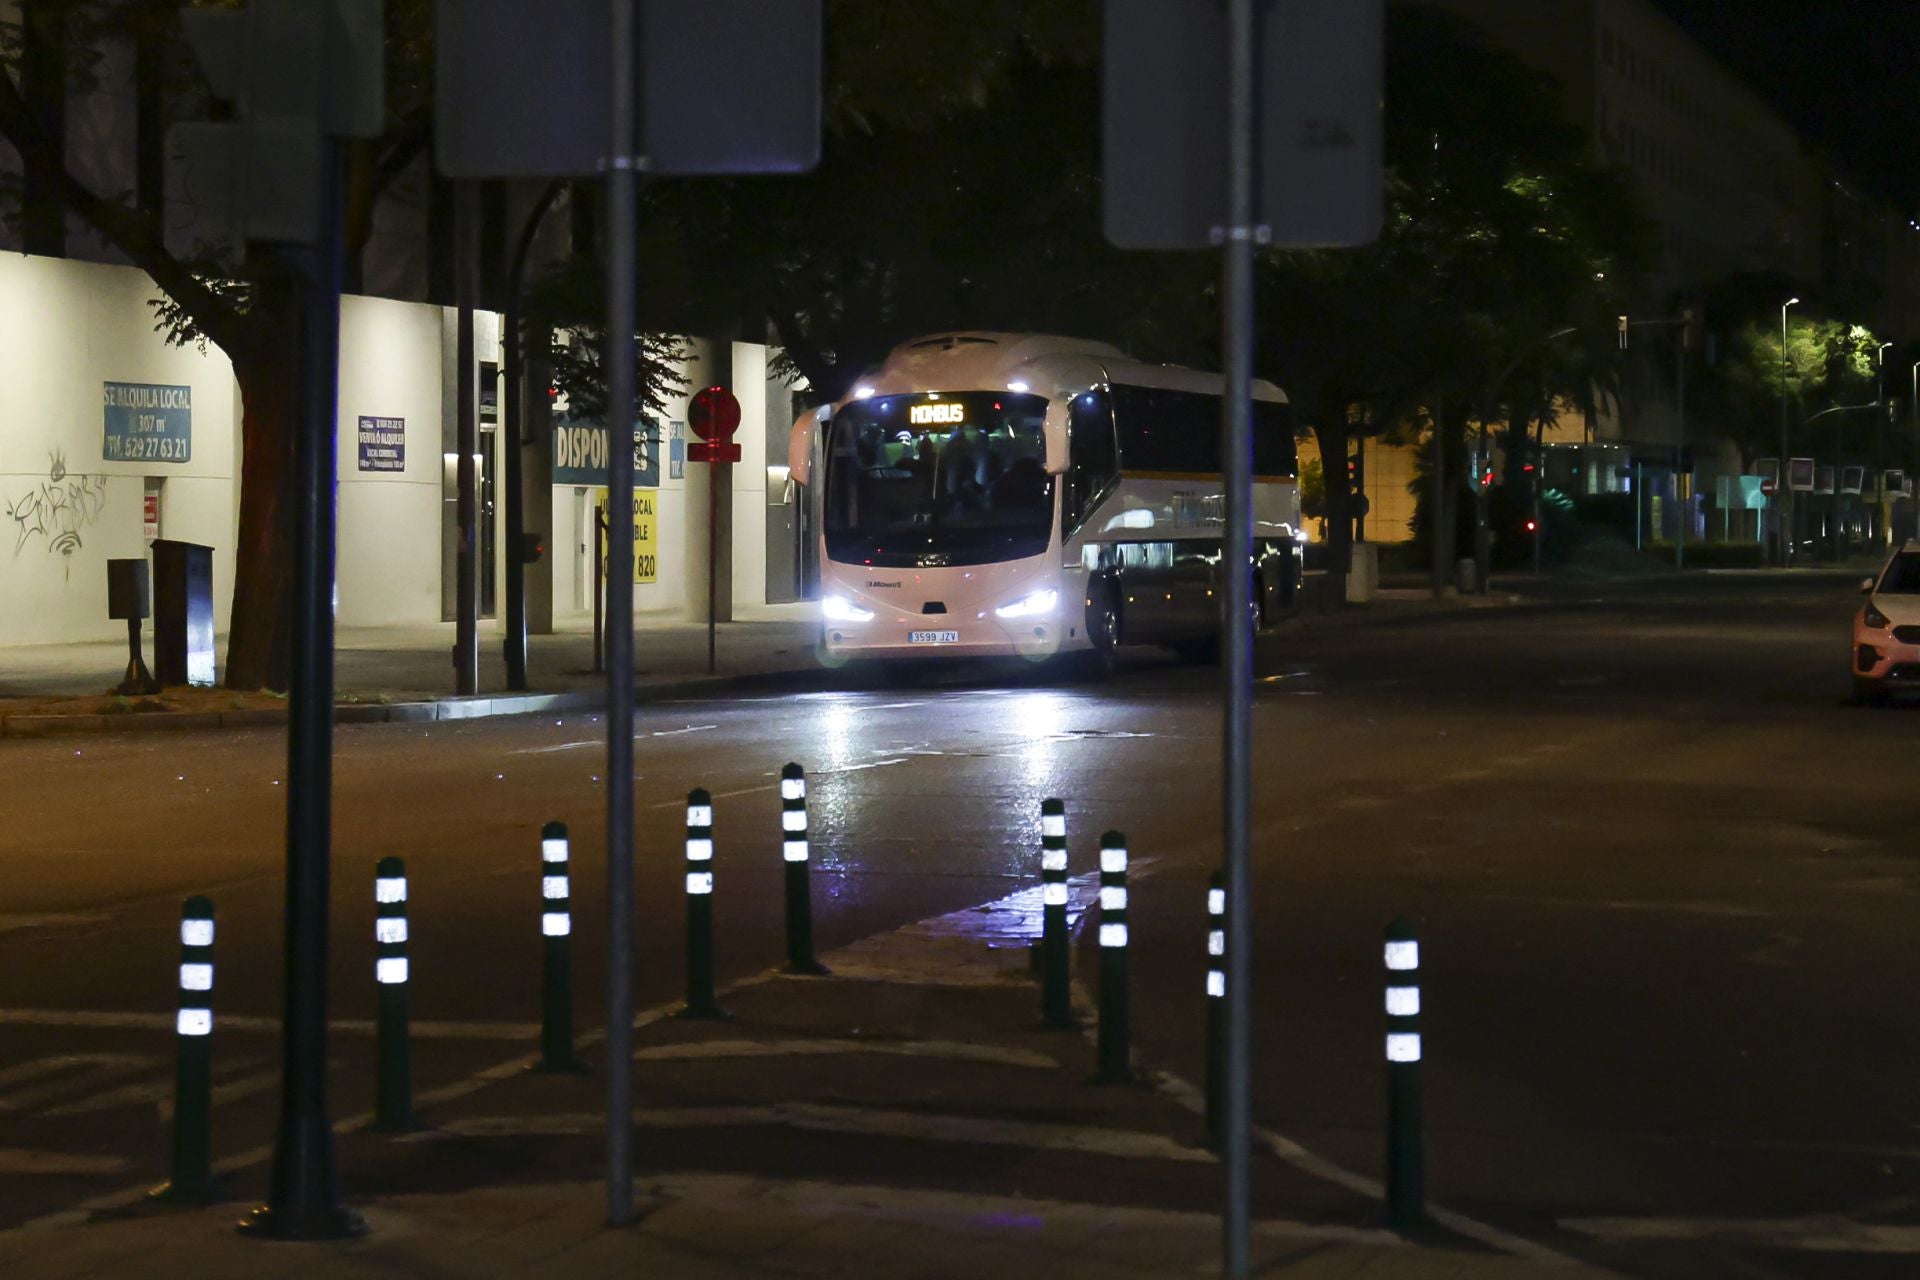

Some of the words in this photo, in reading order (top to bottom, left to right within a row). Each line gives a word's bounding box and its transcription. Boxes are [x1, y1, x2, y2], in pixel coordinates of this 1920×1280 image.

[104, 386, 116, 406] SE
[118, 387, 158, 408] ALQUILA
[160, 389, 190, 409] LOCAL
[146, 438, 159, 457] 27
[160, 438, 173, 458] 63
[174, 438, 187, 458] 21
[632, 499, 653, 515] OCAL
[637, 554, 655, 577] 820
[913, 632, 937, 642] 3599
[940, 632, 956, 642] JZV
